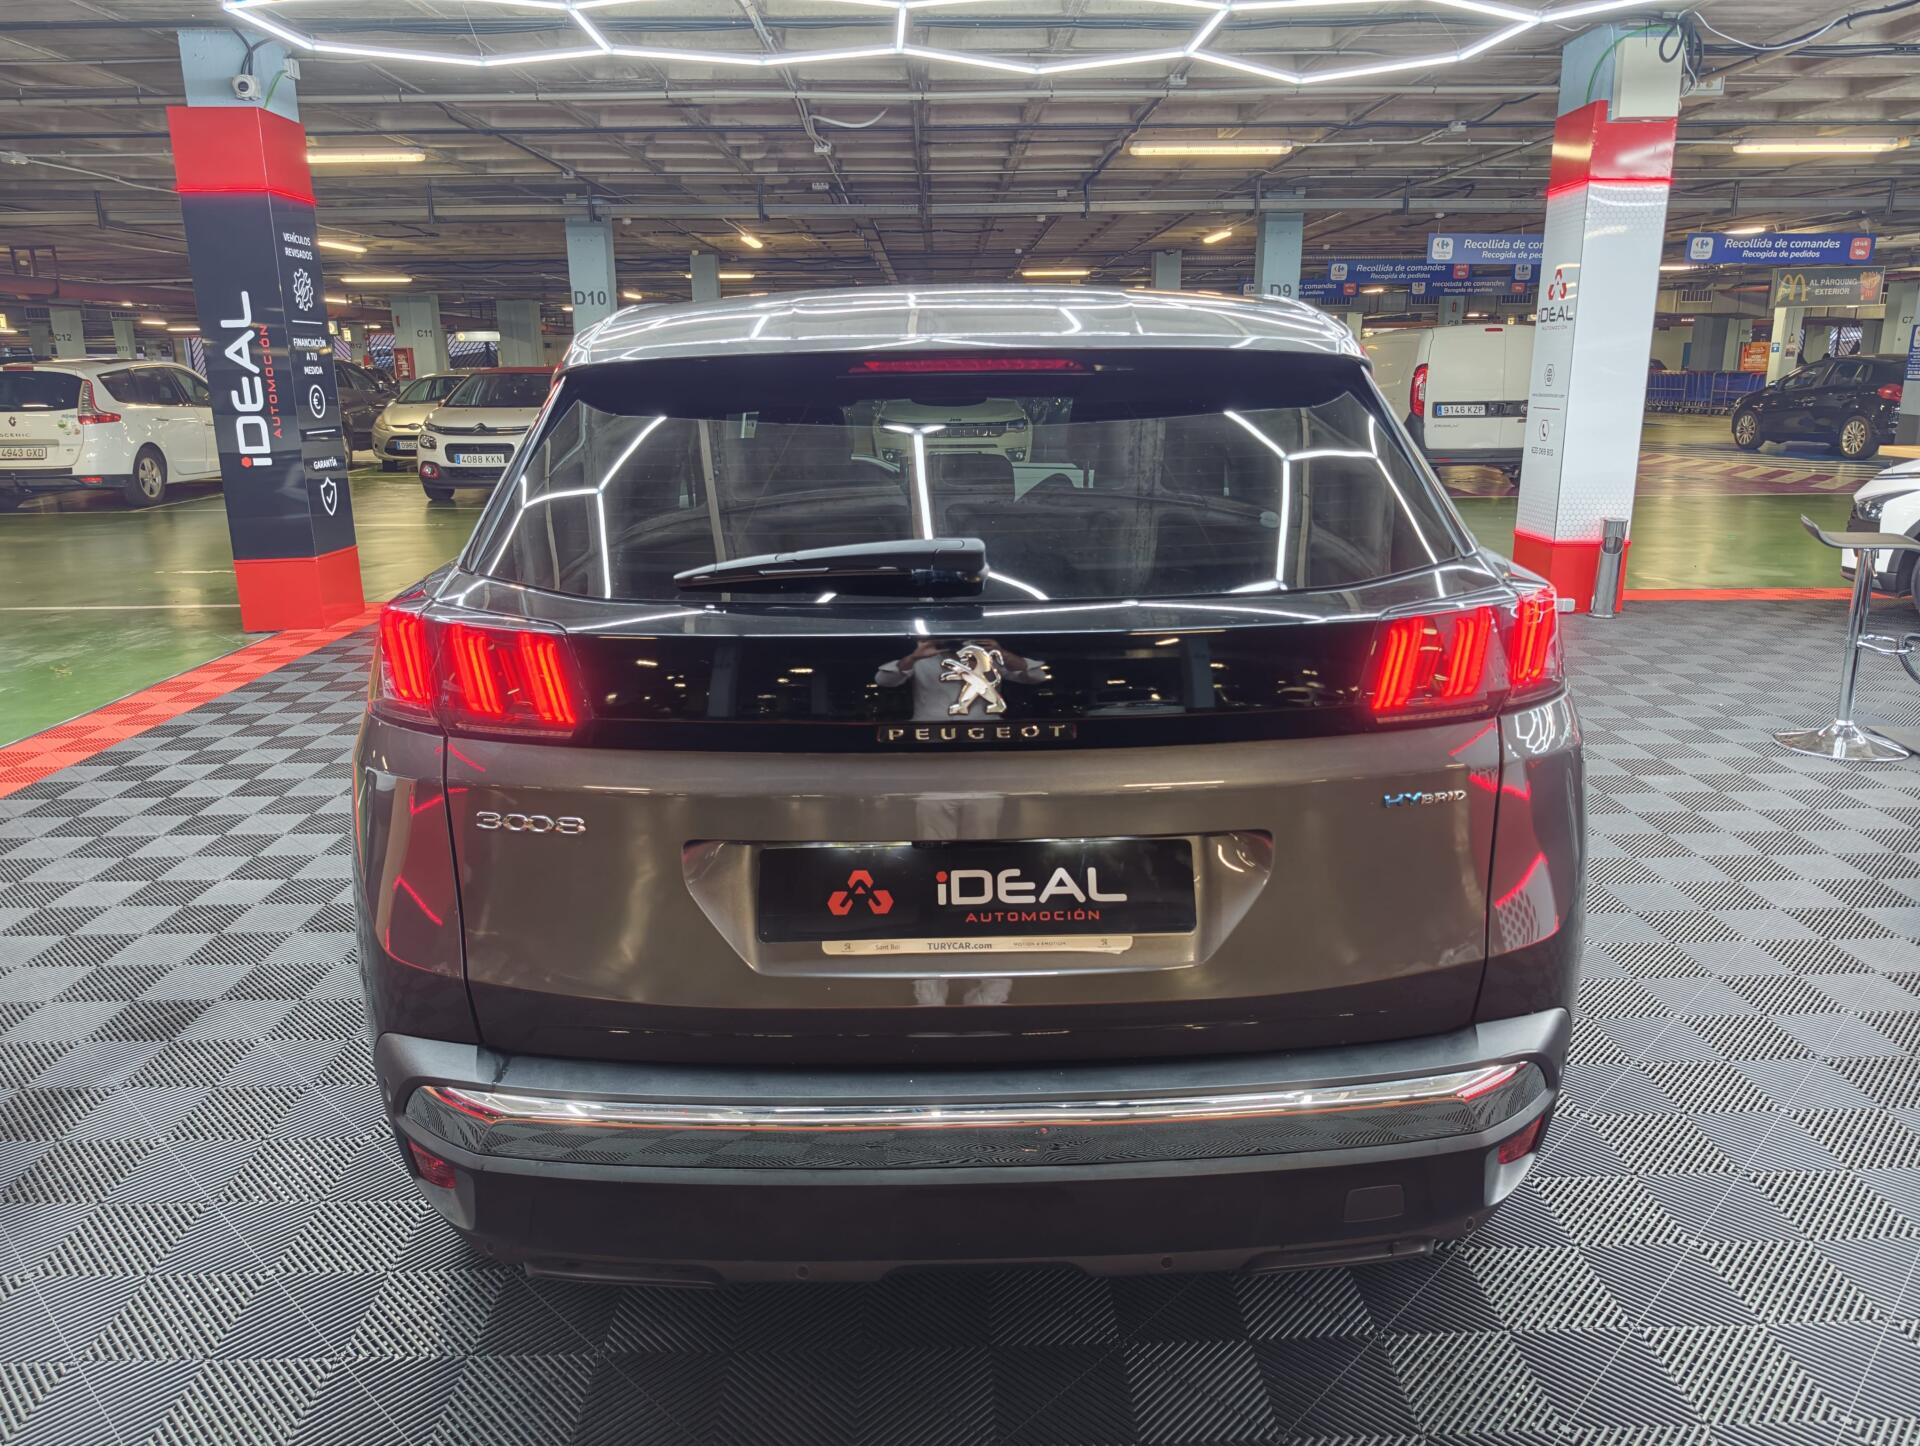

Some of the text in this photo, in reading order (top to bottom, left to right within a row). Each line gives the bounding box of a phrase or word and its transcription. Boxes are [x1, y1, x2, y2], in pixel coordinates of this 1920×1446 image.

[283, 232, 311, 246] VEHÍCULOS
[1464, 239, 1510, 249] Recollida
[1512, 240, 1527, 249] de
[1724, 238, 1841, 248] Recollida de comandes
[284, 247, 313, 260] REVISADOS
[1482, 251, 1517, 260] Recogida
[1518, 251, 1528, 259] de
[1742, 250, 1820, 259] Recogida de pedidos
[1356, 264, 1393, 272] Recollida
[1395, 264, 1406, 272] de
[1406, 264, 1446, 272] comandes
[1270, 284, 1292, 297] D9
[1815, 287, 1850, 296] EXTERIOR
[574, 291, 607, 306] D10
[54, 333, 72, 341] C12
[416, 329, 433, 338] C11
[293, 337, 326, 348] FINANCIACIÓN
[304, 366, 323, 375] MEDIDA
[259, 324, 282, 439] AUTOMOCIÓN
[1443, 405, 1484, 414] 9146 KZP
[1, 449, 44, 457] 4943 GXD
[313, 457, 338, 470] GARANTÍA
[461, 454, 503, 464] 4088 KKN
[888, 724, 1067, 741] PEUGEOT
[476, 811, 586, 834] 3008
[936, 867, 1128, 906] iDEAL
[965, 907, 1101, 923] AUTOMOCIÓN
[927, 942, 993, 951] TURYCAR.com
